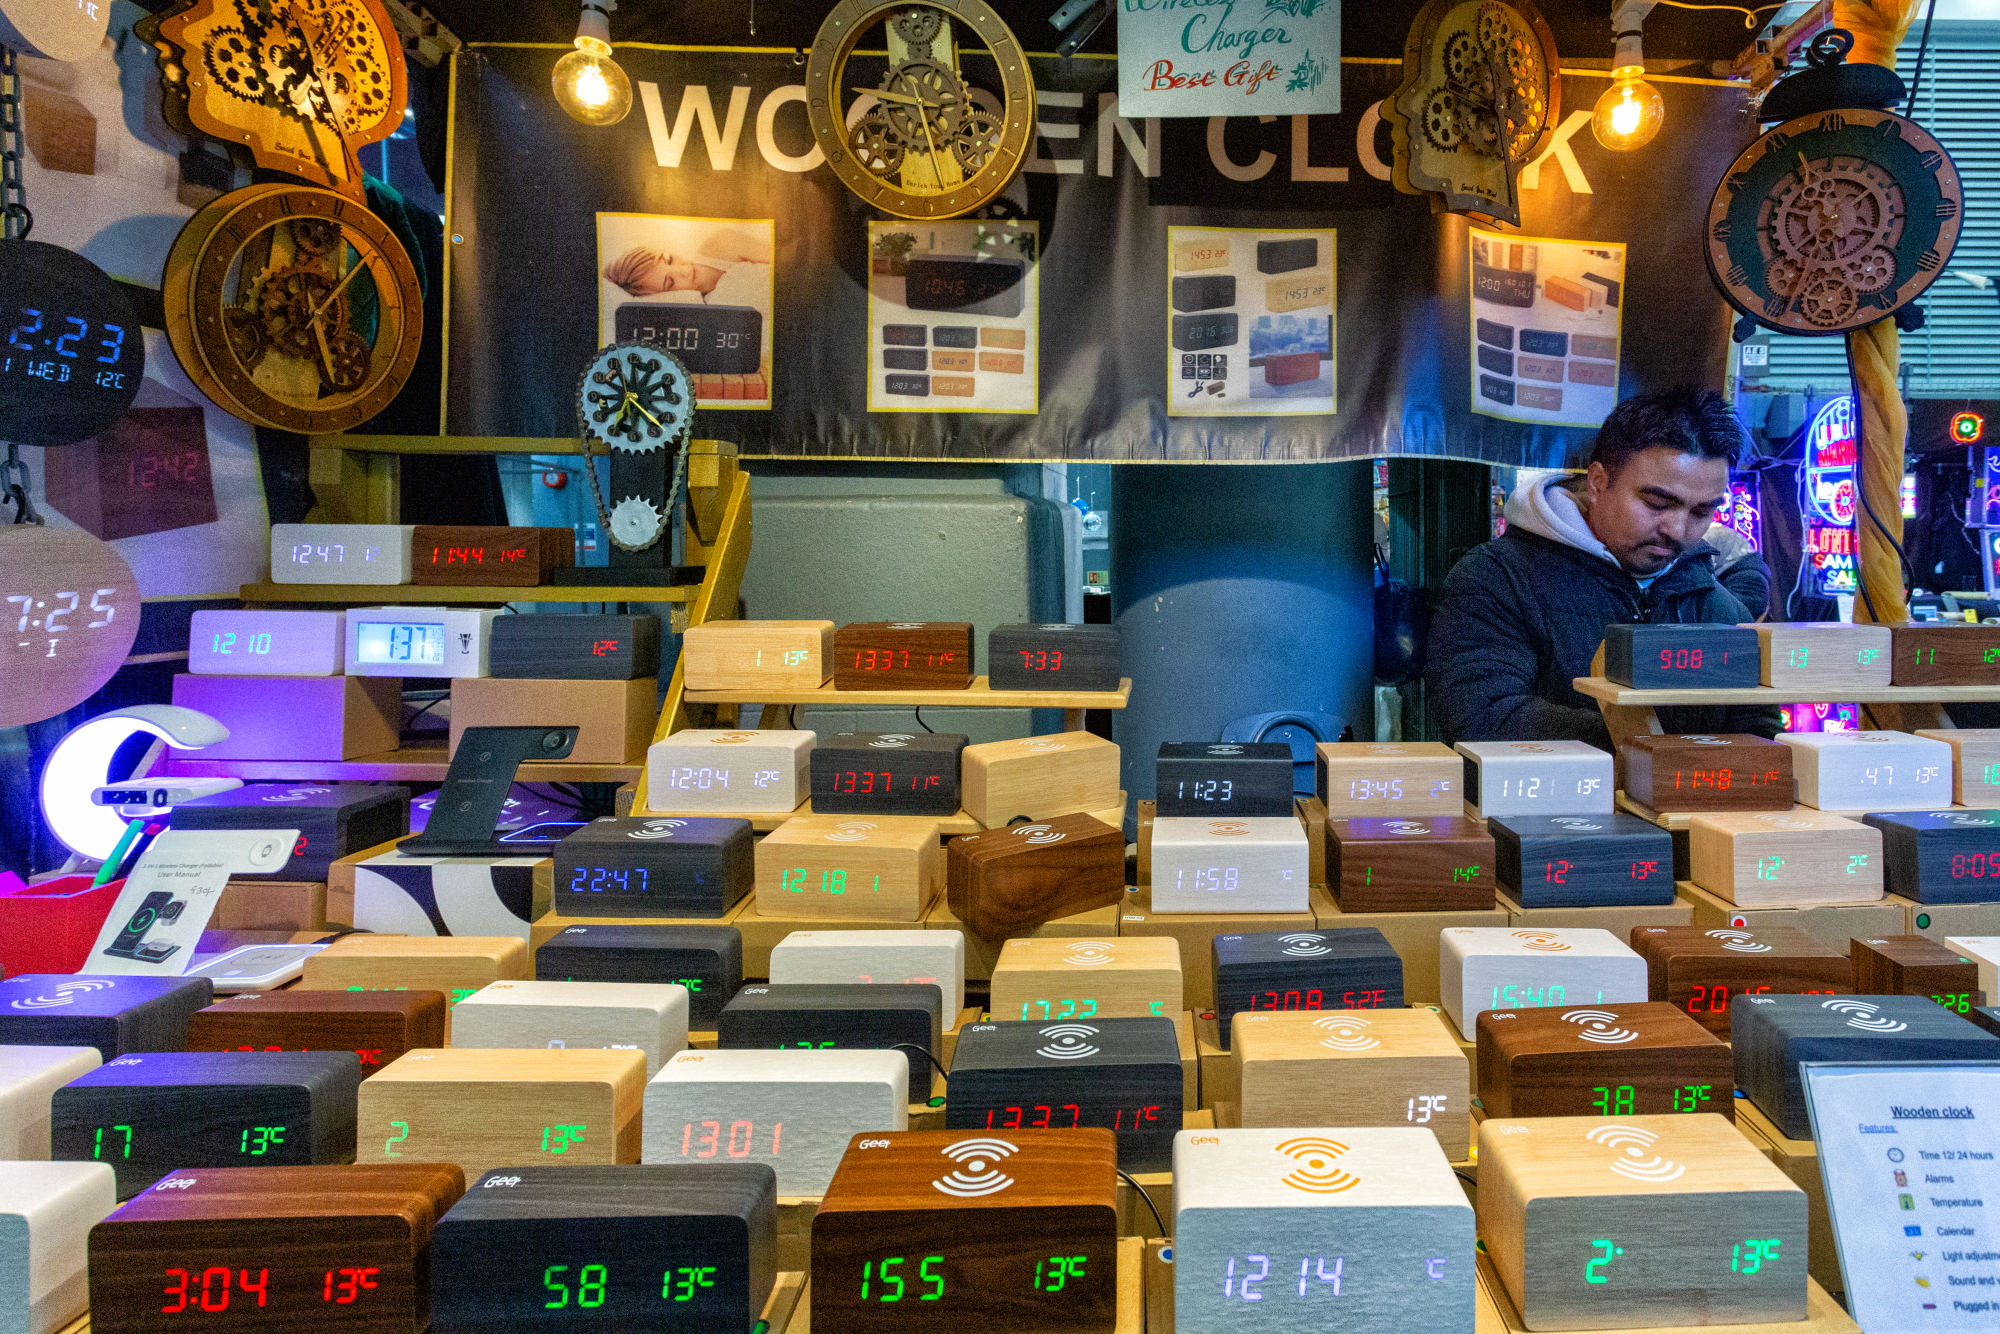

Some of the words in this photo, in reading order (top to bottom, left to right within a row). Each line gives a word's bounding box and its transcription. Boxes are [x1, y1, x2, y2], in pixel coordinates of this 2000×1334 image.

[1181, 5, 1292, 58] Charger
[1142, 60, 1218, 91] Best
[1223, 60, 1283, 95] Gift
[639, 81, 1161, 178] WOEN
[1206, 98, 1594, 194] CLK
[28, 361, 71, 382] WED
[6, 588, 117, 632] 7:25
[389, 626, 427, 660] 1:37
[854, 650, 910, 670] 1337
[1019, 650, 1063, 671] 7:33
[1660, 649, 1703, 669] 908
[1789, 647, 1808, 668] 13
[1915, 648, 1935, 665] 11
[669, 767, 730, 789] 12:04
[833, 771, 892, 793] 1337
[1675, 769, 1732, 791] 11:48
[1178, 780, 1233, 801] 11:23
[1350, 779, 1403, 800] 13:45
[570, 867, 649, 893] 22:47
[1177, 867, 1239, 892] 11:58
[1366, 867, 1372, 886] 1
[1891, 1106, 1939, 1119] Wooden
[1942, 1106, 1975, 1119] clock
[384, 1121, 409, 1157] 2
[681, 1120, 783, 1158] 1301
[1858, 1123, 1899, 1134] Features:
[93, 1125, 133, 1158] 17
[1919, 1151, 1940, 1160] Time
[1957, 1151, 1968, 1160] 24
[1969, 1150, 1994, 1160] hours
[1925, 1174, 1954, 1184] Alarms
[1930, 1198, 1983, 1208] Temperature
[1936, 1226, 1975, 1236] Calendar
[1942, 1251, 1963, 1263] Light
[161, 1266, 269, 1314] 3:04
[543, 1264, 608, 1309] 58
[1947, 1275, 1976, 1286] Sound
[1978, 1276, 1994, 1286] and
[1953, 1301, 1990, 1313] Plugged
